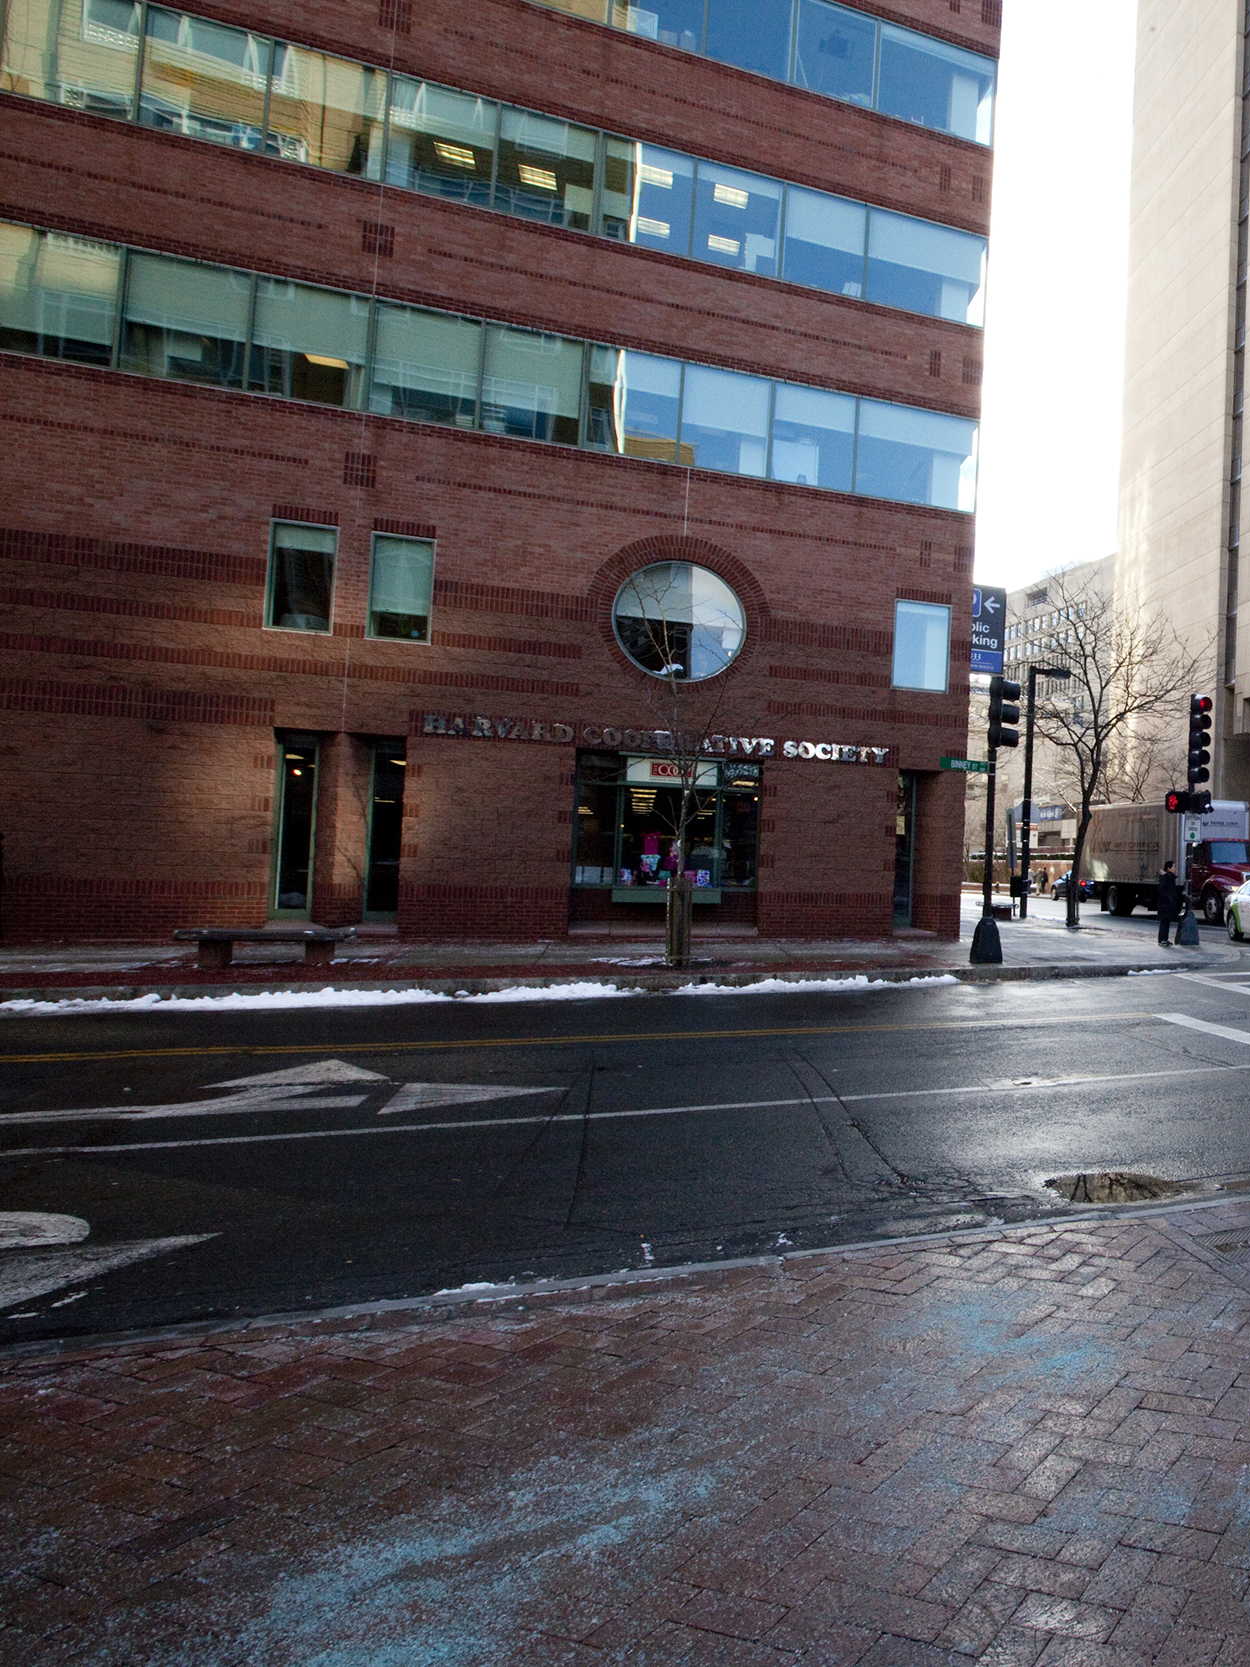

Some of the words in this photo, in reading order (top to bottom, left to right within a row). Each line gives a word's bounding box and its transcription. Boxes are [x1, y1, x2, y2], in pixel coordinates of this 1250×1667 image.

[423, 714, 575, 743] HARVARD
[783, 740, 889, 765] SOCIETY
[951, 760, 971, 770] BINNEY
